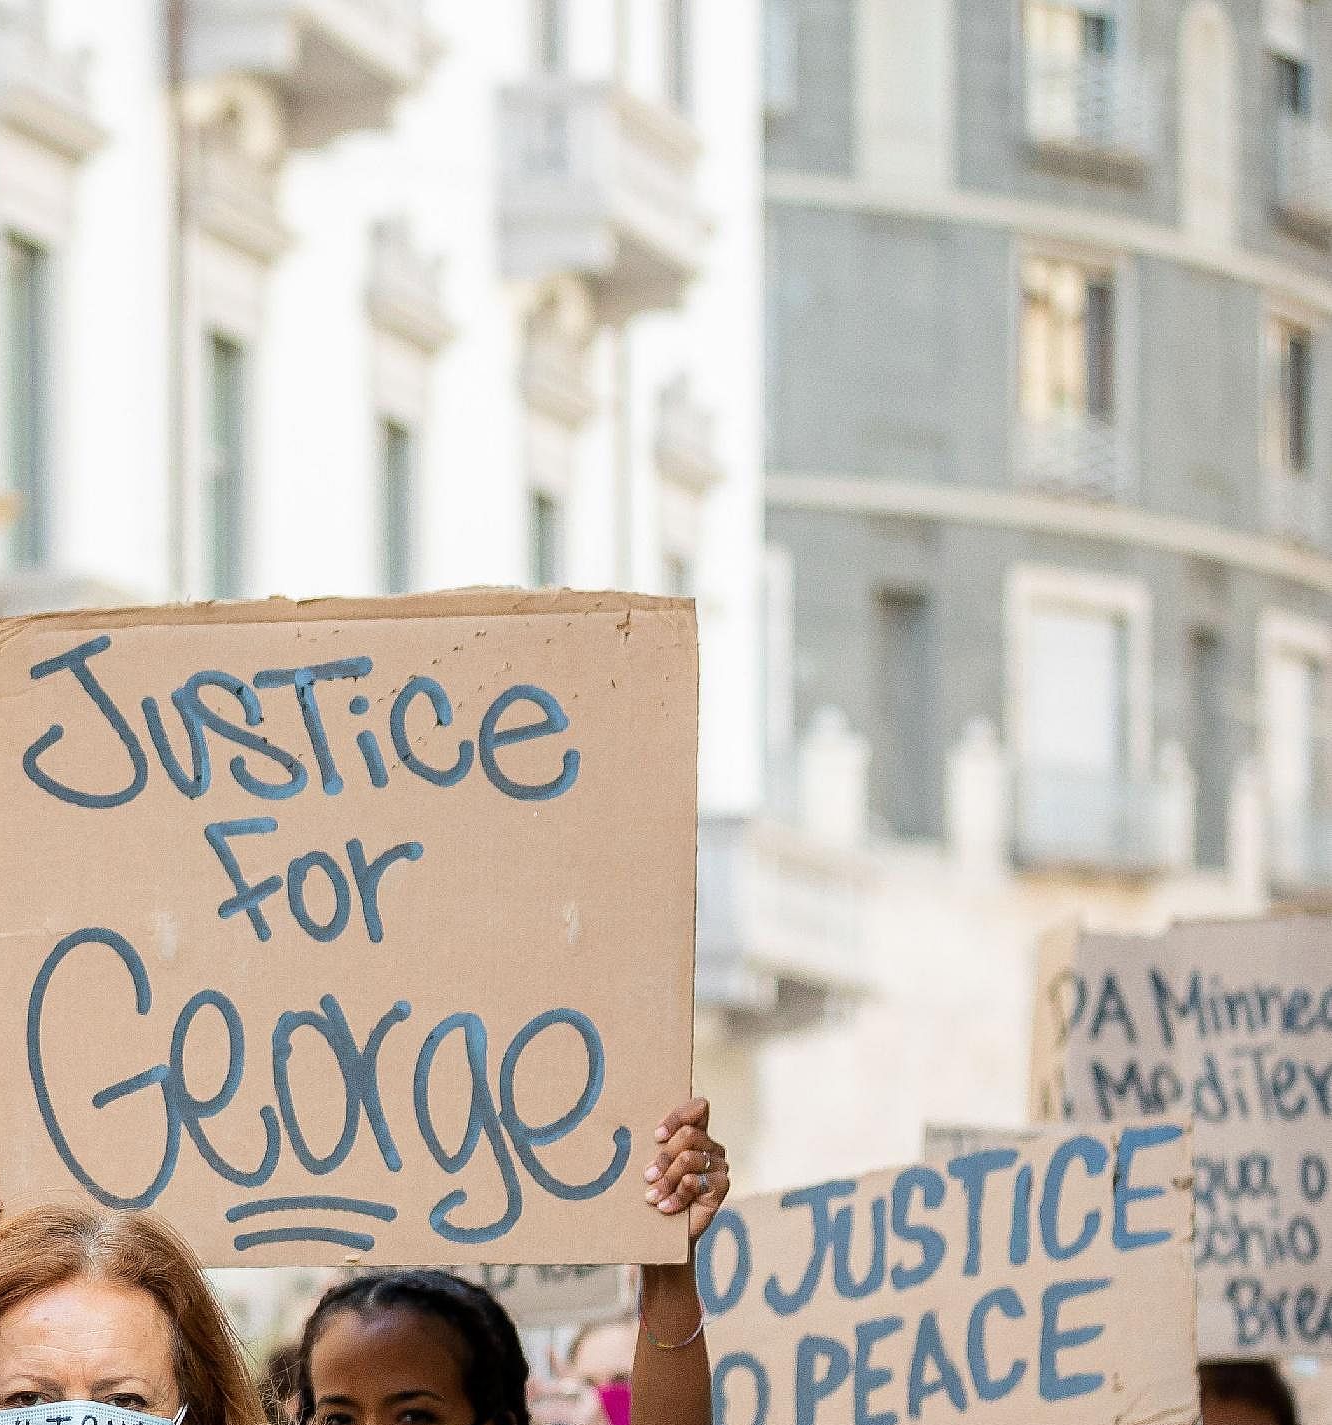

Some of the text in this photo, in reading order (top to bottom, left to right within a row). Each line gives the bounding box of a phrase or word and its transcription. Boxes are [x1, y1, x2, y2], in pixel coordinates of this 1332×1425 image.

[205, 816, 423, 943] For
[27, 927, 631, 1243] George
[696, 1125, 1185, 1317] O JUSTICE
